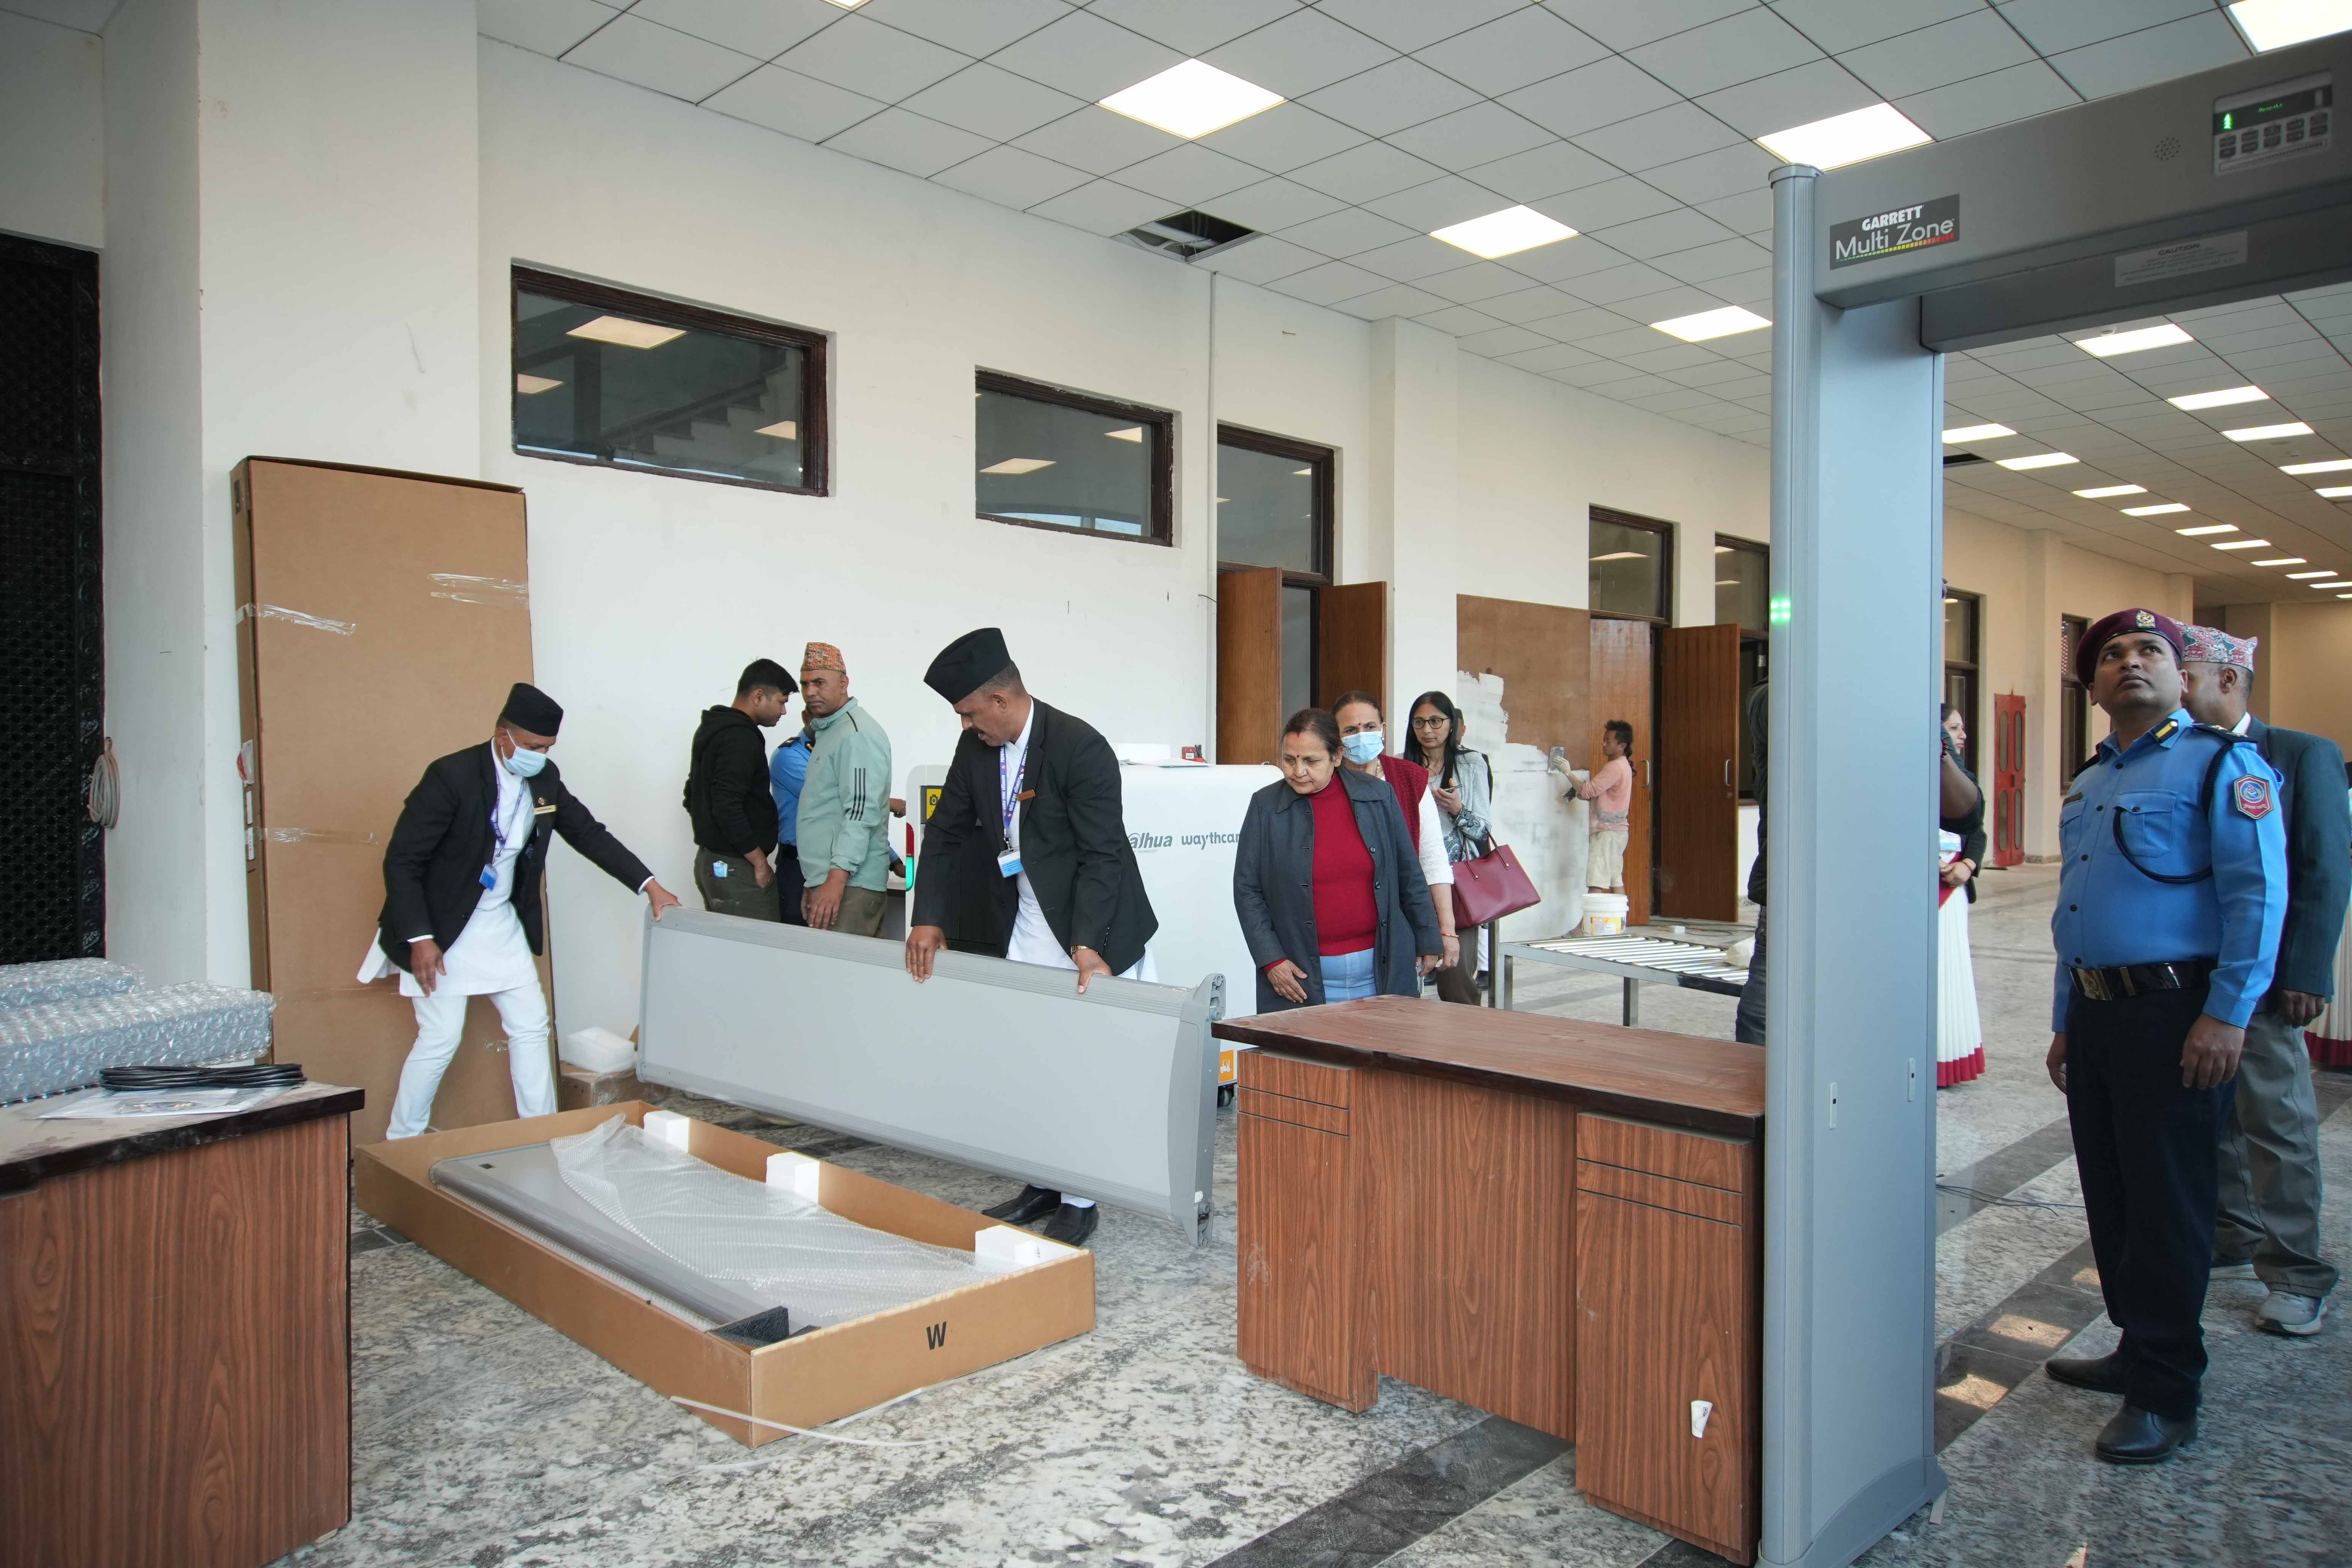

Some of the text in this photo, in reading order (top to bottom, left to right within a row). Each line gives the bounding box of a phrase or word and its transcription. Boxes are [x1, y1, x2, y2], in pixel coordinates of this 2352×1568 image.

[1862, 204, 1923, 231] GARRETT
[1836, 219, 1954, 260] Multi Zone
[2158, 243, 2200, 256] CAUTION
[926, 1321, 947, 1350] W
